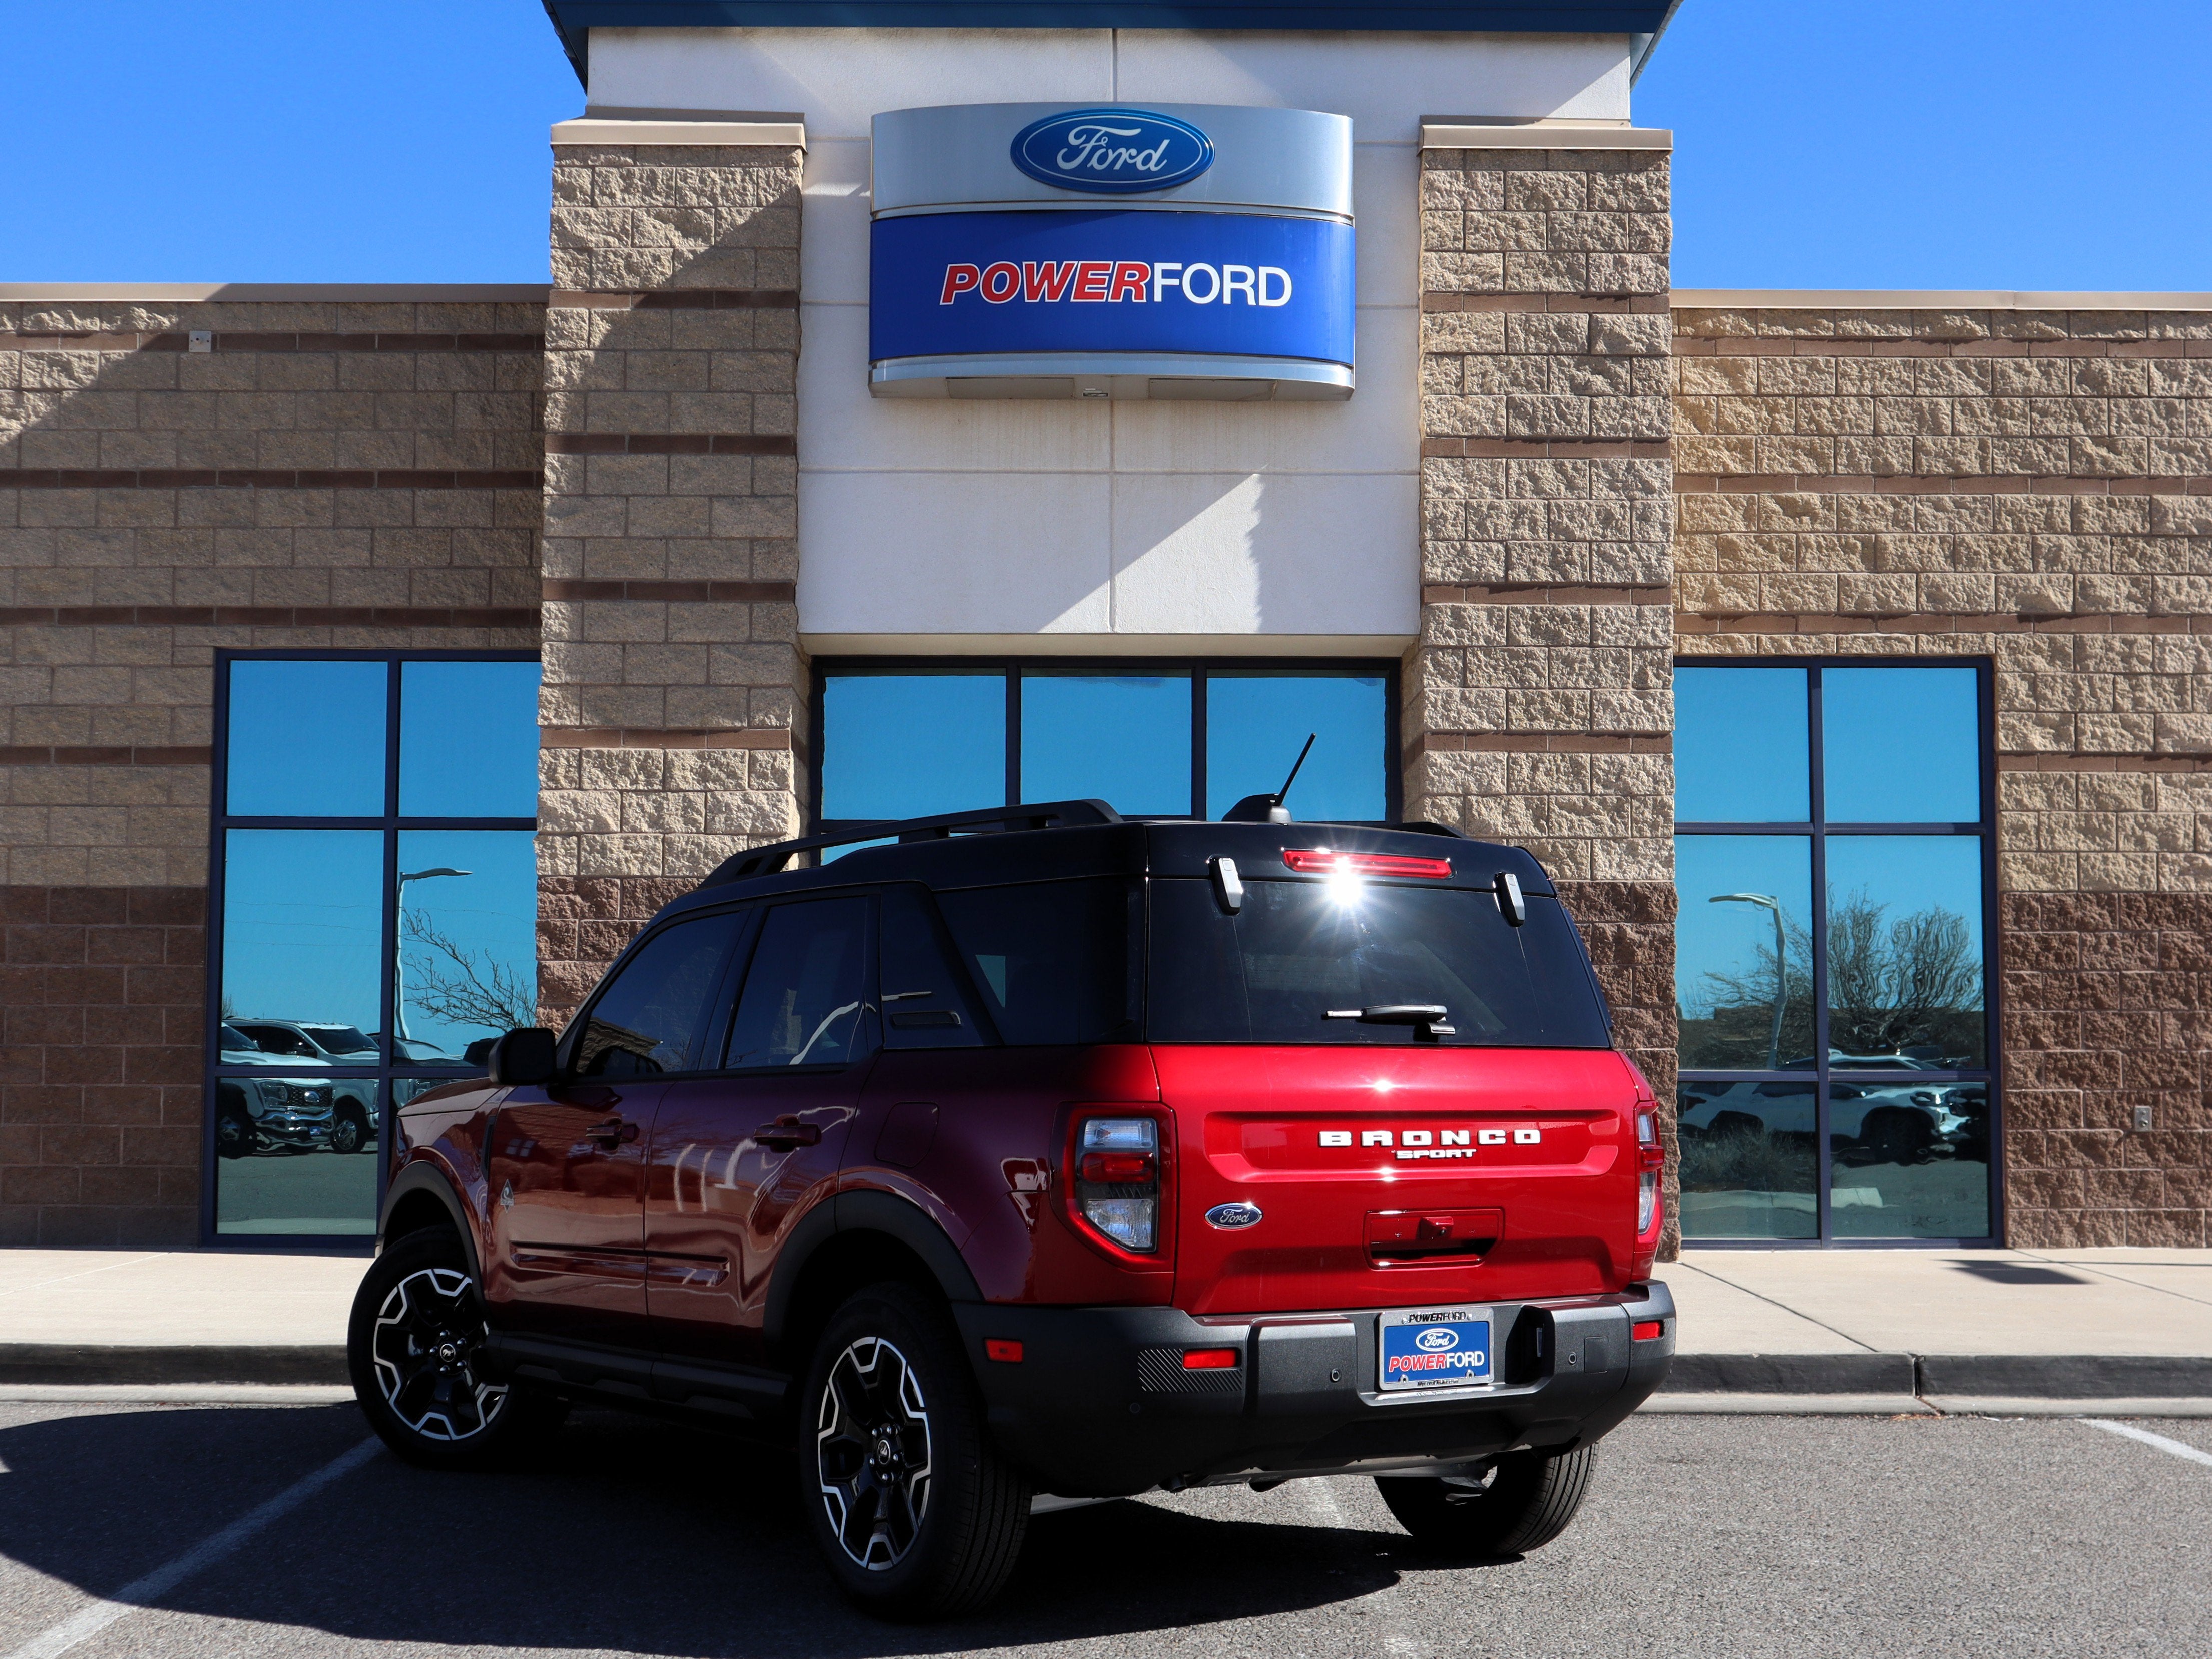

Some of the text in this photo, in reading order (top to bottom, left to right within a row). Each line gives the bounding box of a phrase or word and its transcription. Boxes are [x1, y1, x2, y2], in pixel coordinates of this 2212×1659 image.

[1057, 125, 1170, 172] Ford
[1319, 1129, 1541, 1146] BRONCO
[1396, 1149, 1477, 1159] SPORT
[1220, 1209, 1250, 1223] Ford
[1425, 1333, 1450, 1347] Ford
